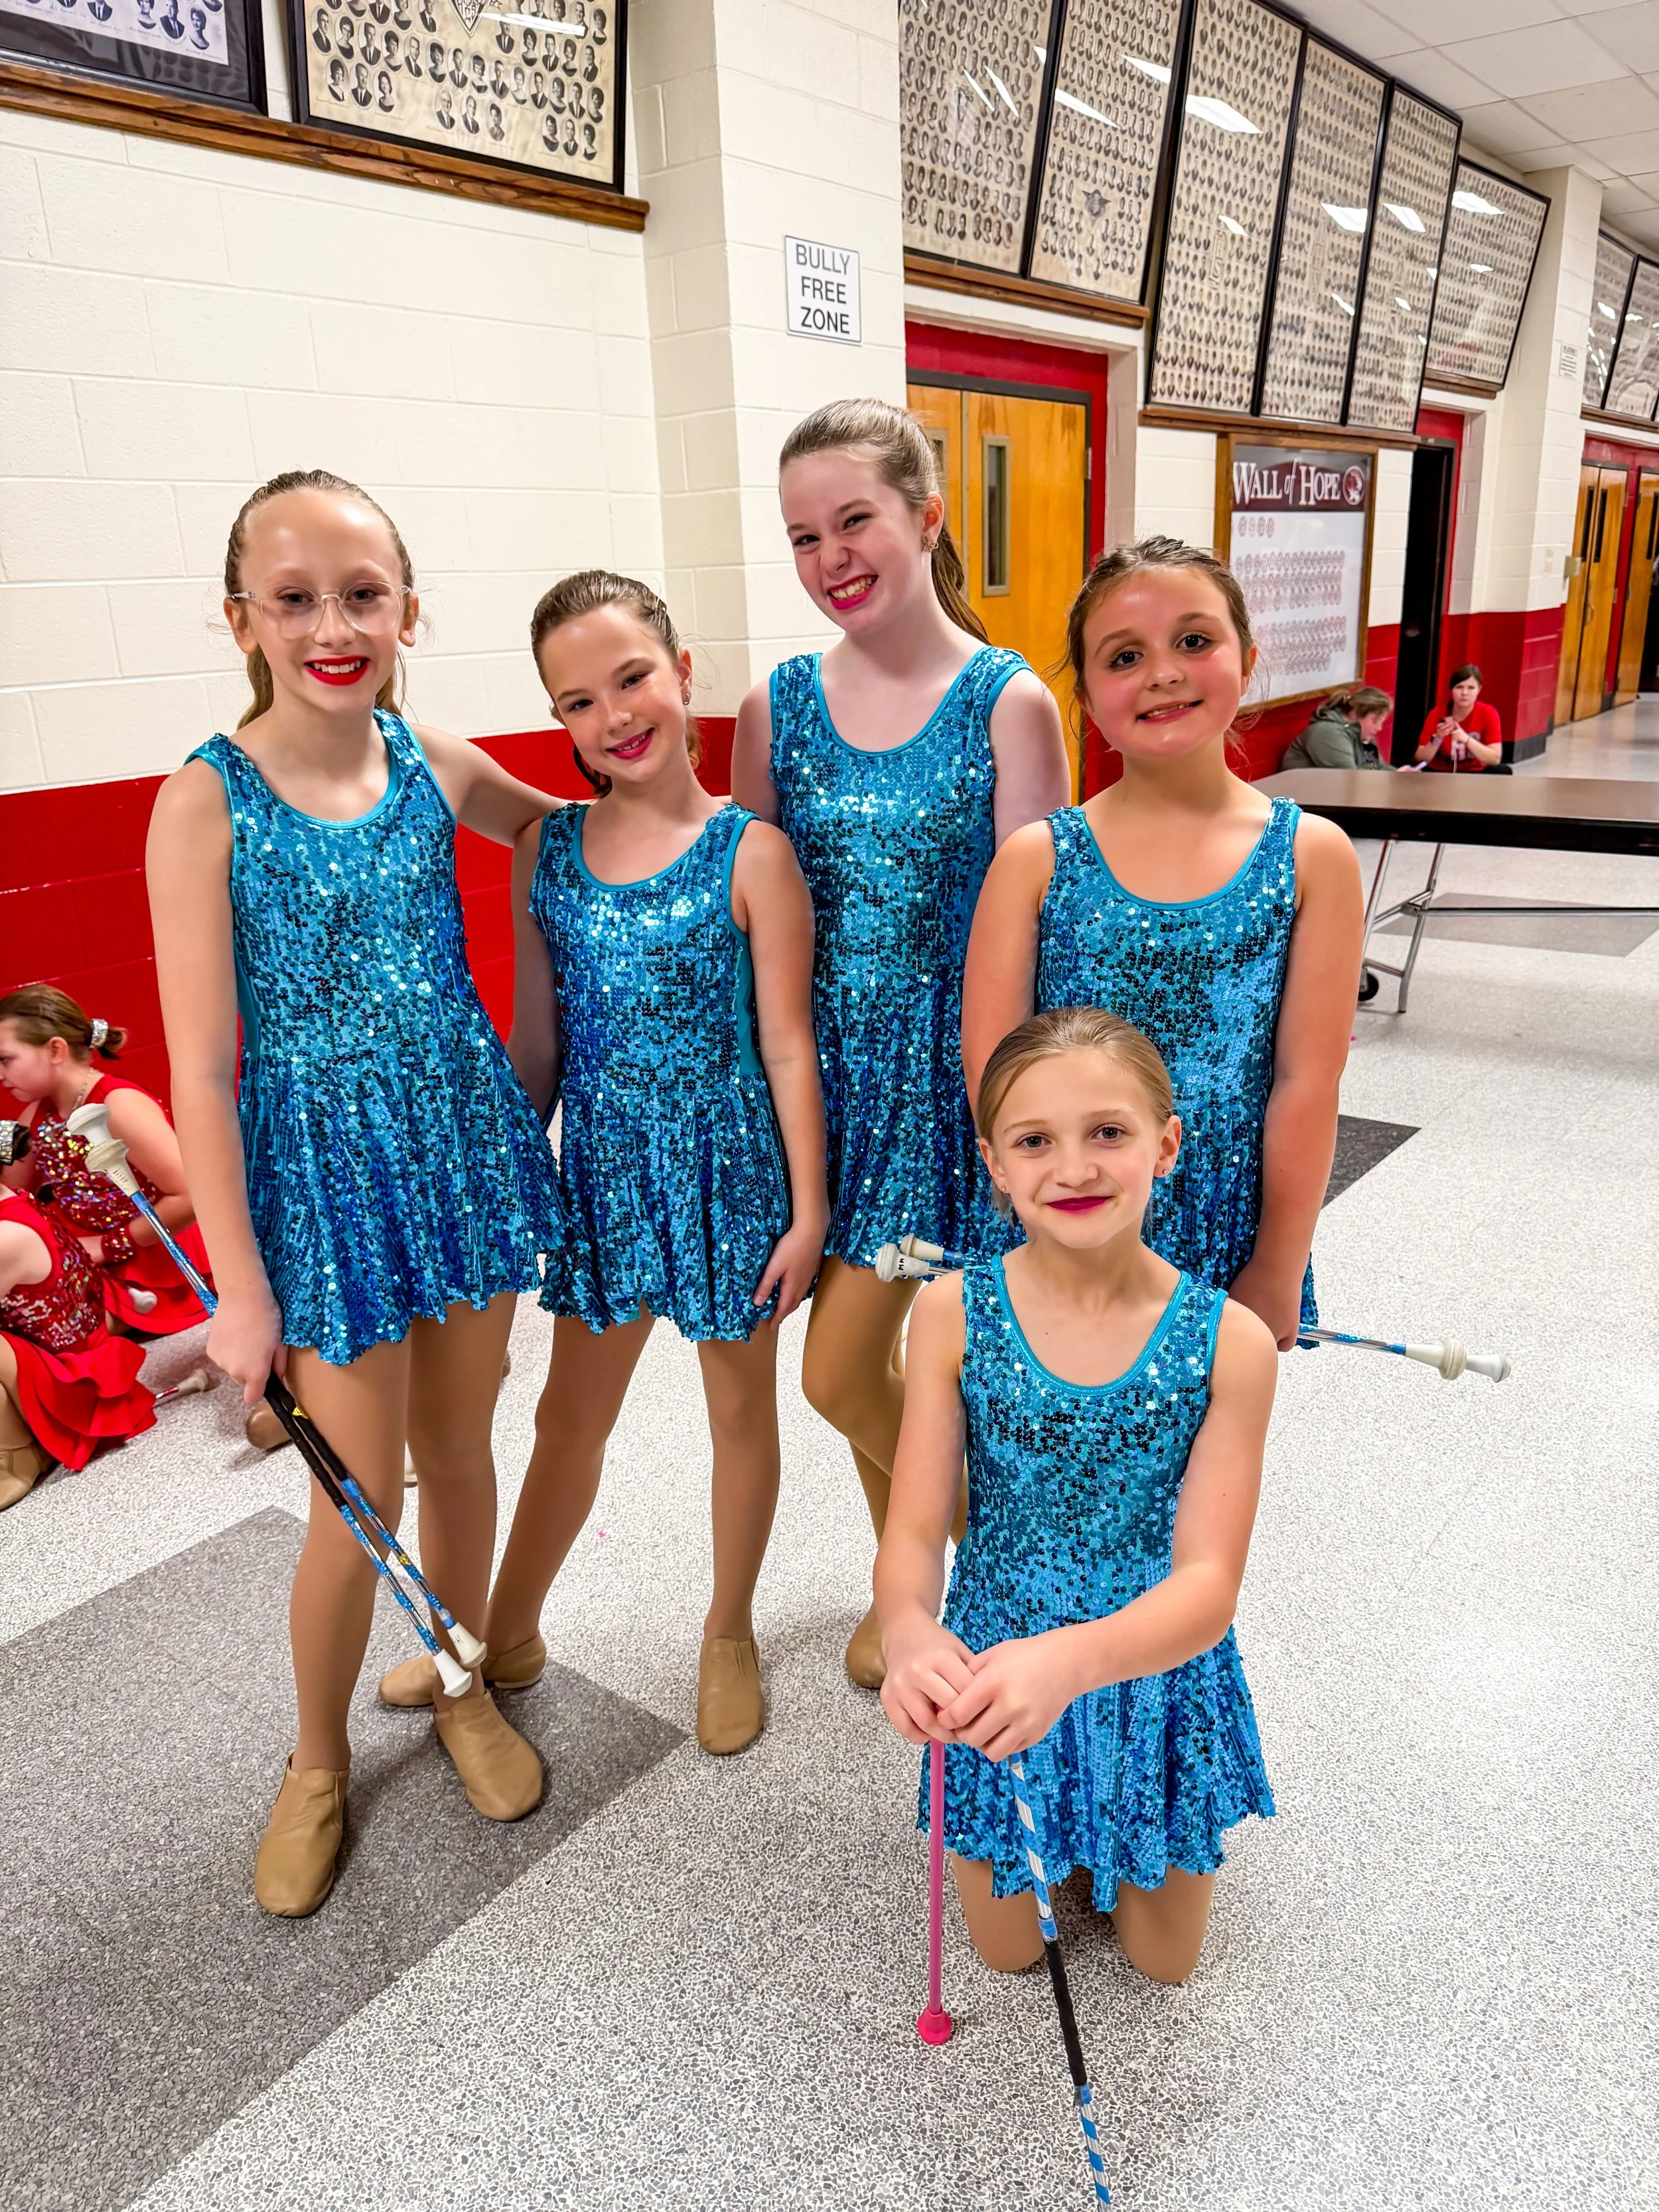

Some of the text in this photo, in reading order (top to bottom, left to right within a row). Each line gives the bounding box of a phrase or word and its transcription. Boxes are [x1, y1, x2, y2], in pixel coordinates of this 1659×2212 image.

[796, 244, 849, 275] BULLY
[801, 275, 846, 304] FREE
[801, 306, 849, 334] ZONE
[1284, 457, 1303, 504] of
